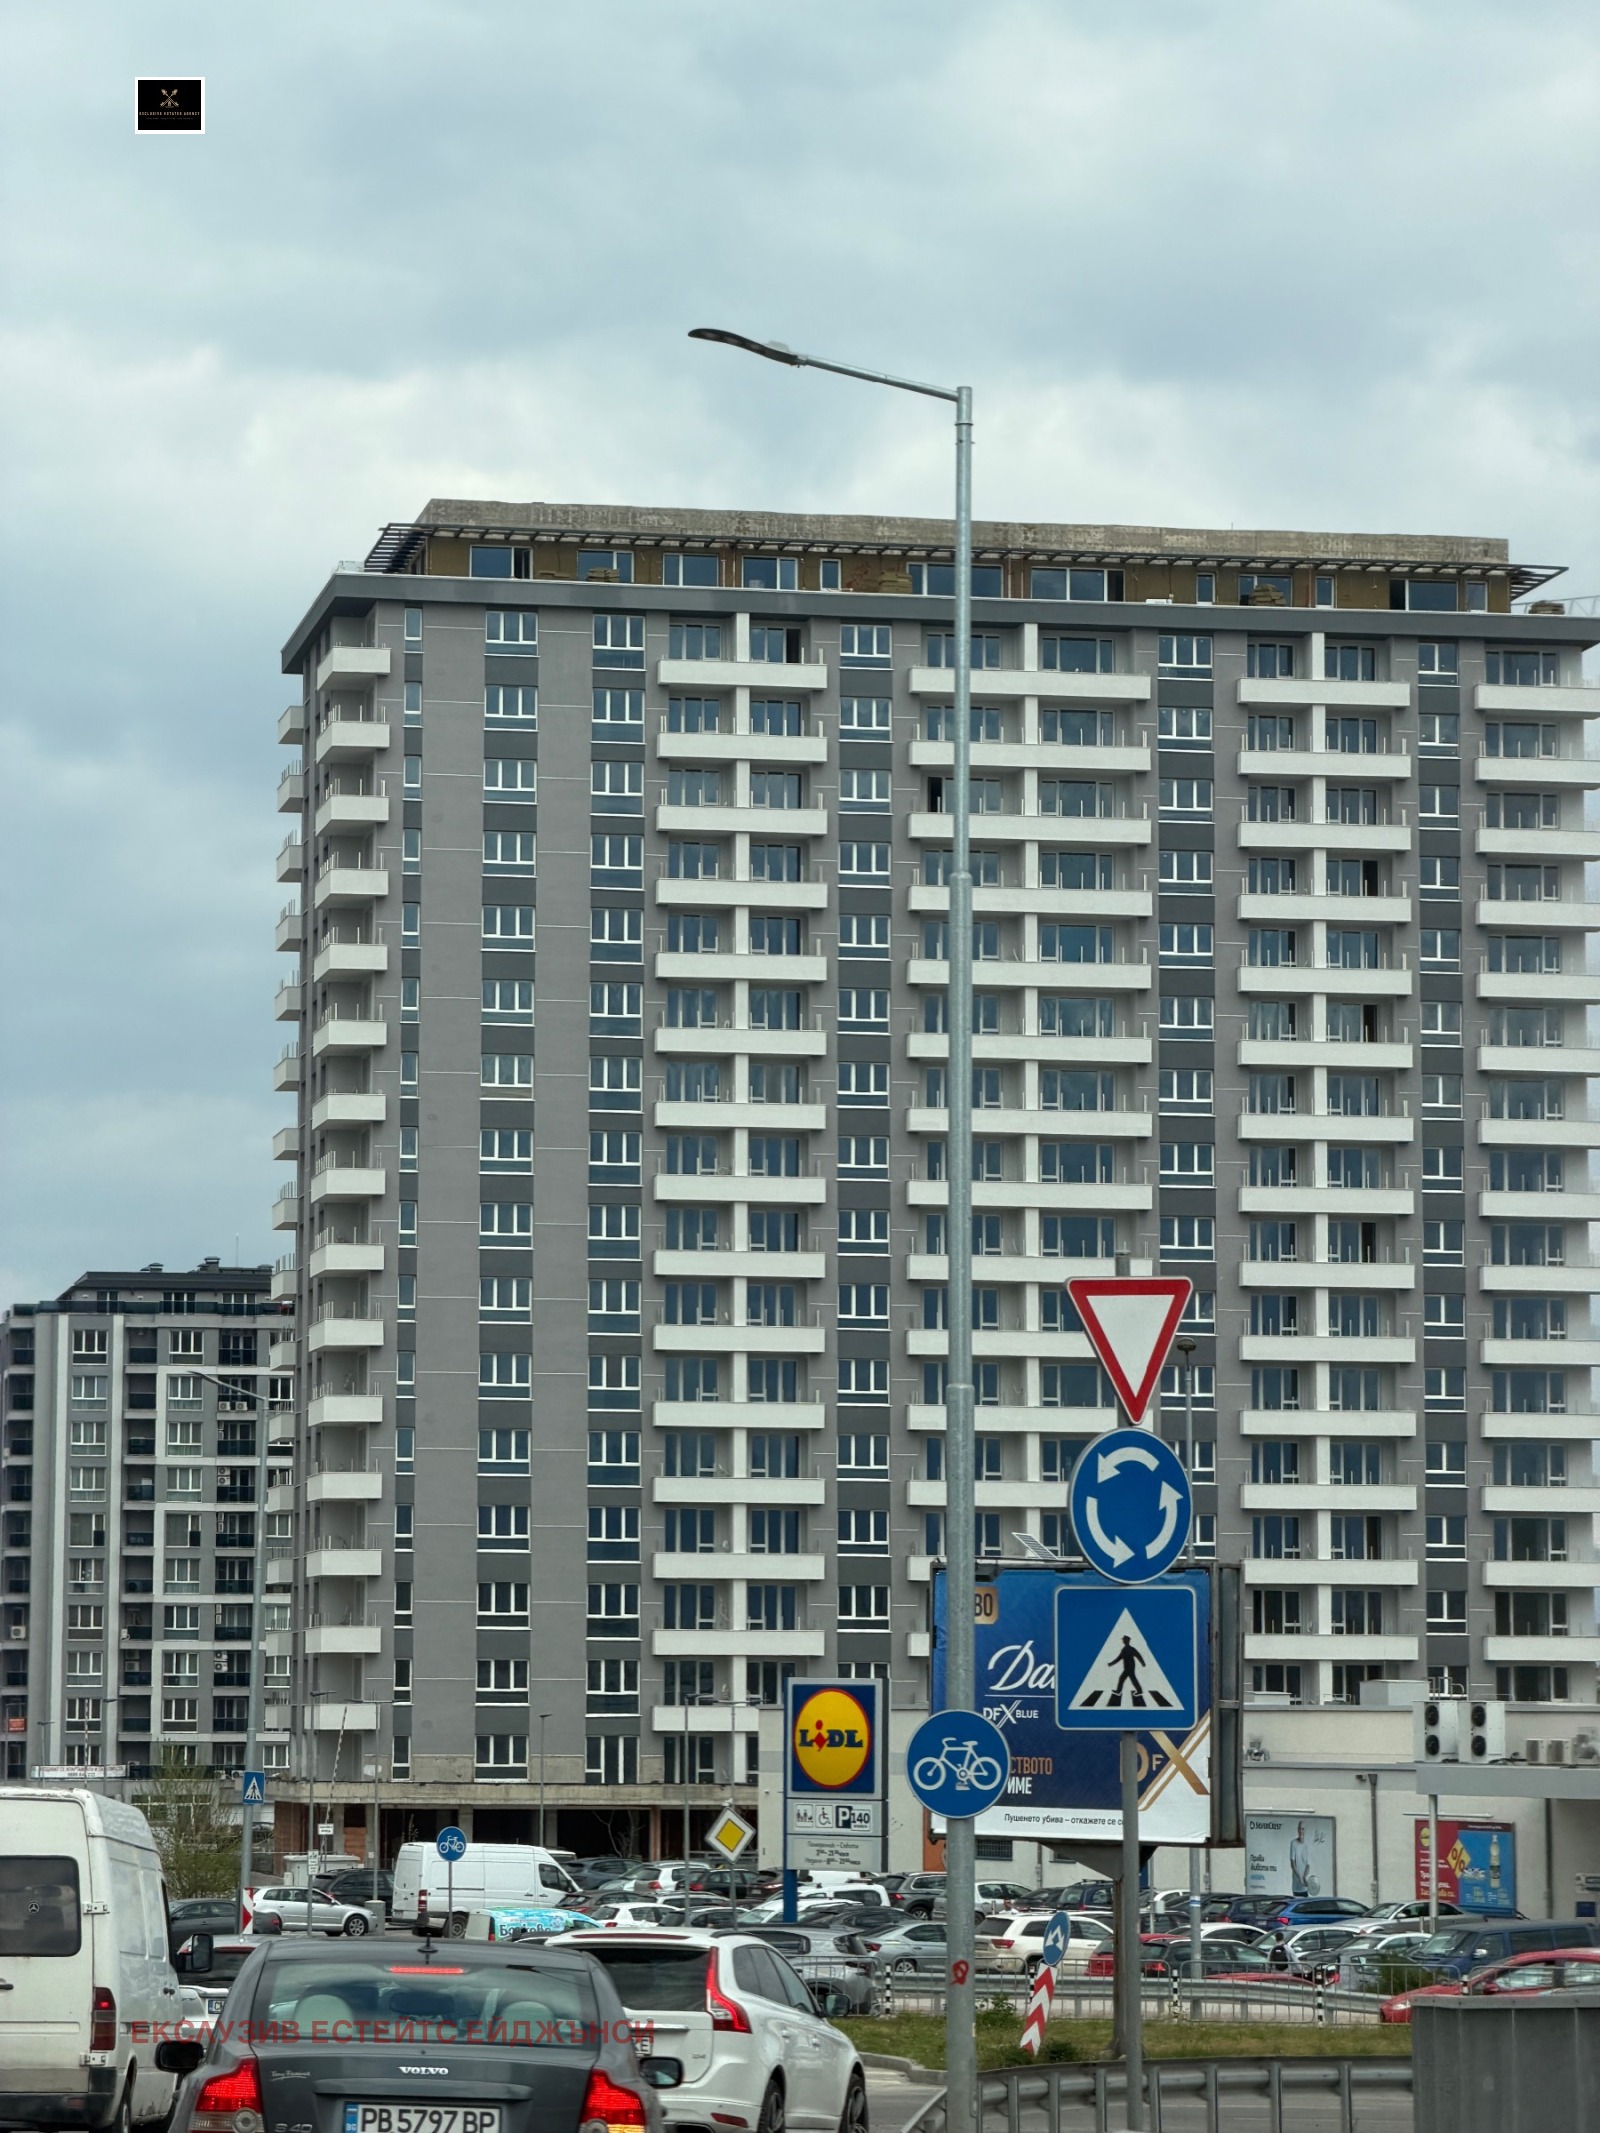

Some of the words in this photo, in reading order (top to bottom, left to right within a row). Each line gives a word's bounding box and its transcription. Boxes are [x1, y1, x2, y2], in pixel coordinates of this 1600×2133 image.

[1015, 1709, 1039, 1719] BLUE
[1010, 1757, 1052, 1775] СТВОТО
[851, 1812, 870, 1824] 140
[1004, 1813, 1041, 1824] Пушенето
[1042, 1815, 1064, 1825] убива
[398, 2066, 449, 2075] VOLVO
[361, 2108, 392, 2133] PB
[398, 2109, 458, 2133] 5797
[463, 2111, 495, 2133] BP
